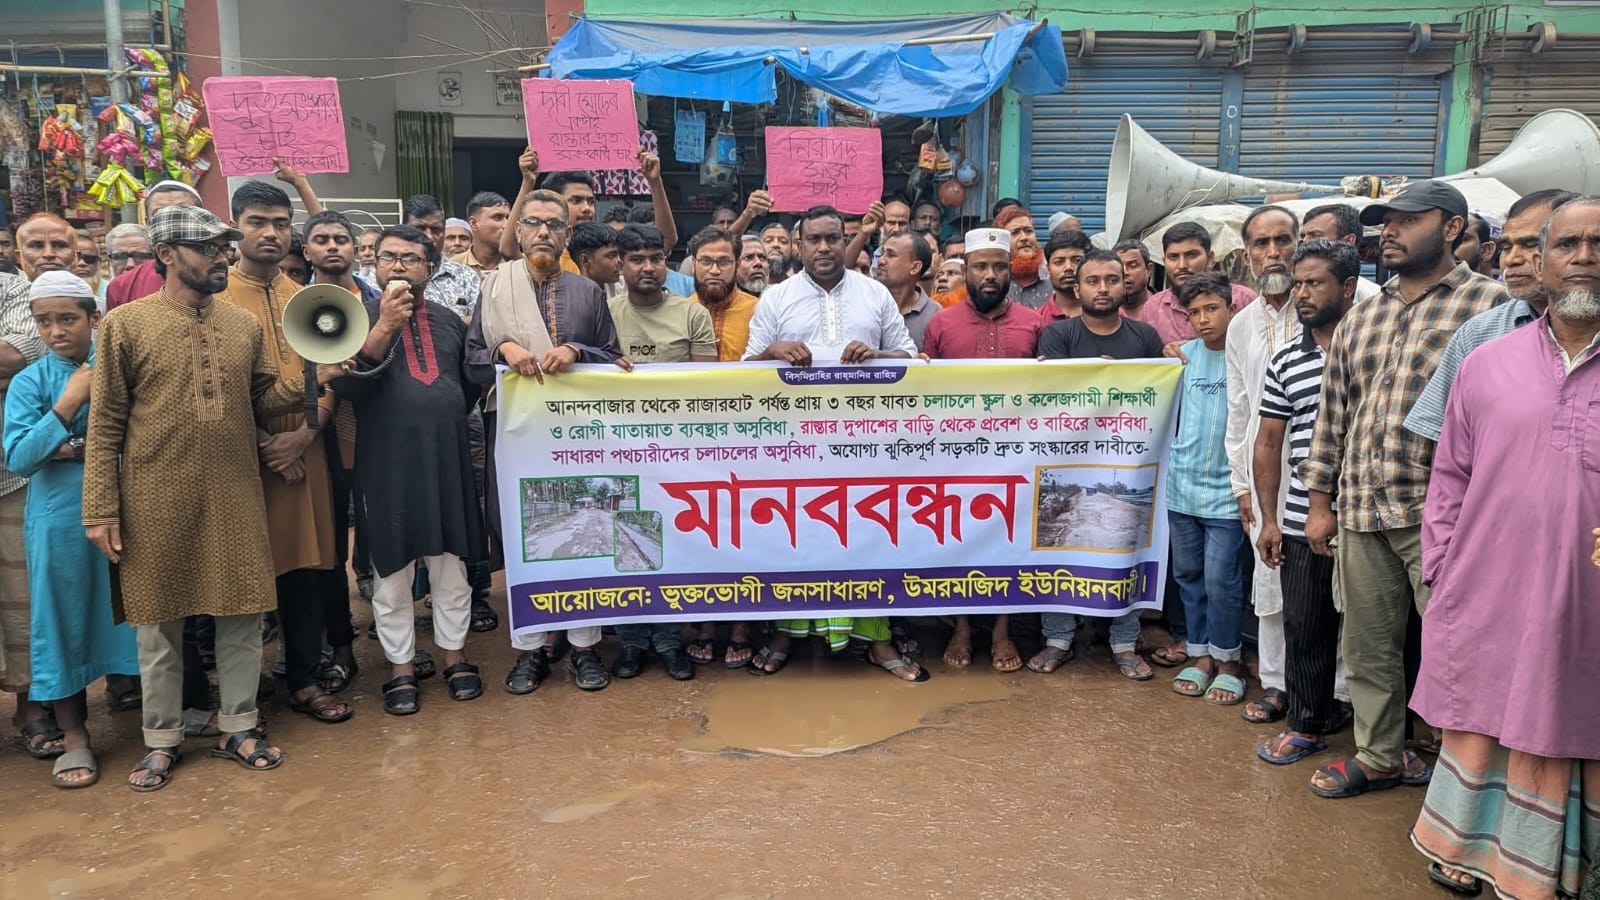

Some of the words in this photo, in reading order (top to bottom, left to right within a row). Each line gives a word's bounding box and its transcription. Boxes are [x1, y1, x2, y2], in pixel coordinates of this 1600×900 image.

[873, 369, 898, 381] রাহিম
[545, 398, 635, 416] আনন্দবাজার
[640, 398, 681, 413] থেকে
[684, 393, 754, 413] রাজারহাট
[759, 392, 790, 411] পর্যন্ত
[795, 395, 822, 411] প্রায়
[827, 398, 839, 409] ৩
[845, 396, 876, 411] বছর
[880, 394, 918, 410] যাবত
[922, 394, 976, 408] চলাচলে
[980, 394, 1005, 412] স্কুল
[1011, 395, 1022, 406] ও
[1027, 387, 1102, 406] কলেজগামী
[1107, 387, 1157, 407] শিক্ষার্থী
[550, 427, 562, 439] ও
[569, 420, 606, 440] রোগী
[610, 423, 673, 439] যাতায়াত
[678, 422, 729, 439] ব্যবস্থার
[800, 420, 838, 434] রাস্তার
[843, 419, 898, 437] দুপাশের
[903, 414, 935, 435] বাড়ি
[940, 418, 976, 432] থেকে
[981, 416, 1021, 432] প্রবেশ
[1027, 418, 1038, 430] ও
[1043, 412, 1090, 432] বাহিরে
[552, 449, 605, 464] সাধারণ
[611, 443, 690, 464] পথচারীদের
[695, 446, 758, 461] চলাচলের
[828, 443, 879, 458] অযোগ্য
[884, 437, 936, 461] ঝুকিপূর্ণ
[939, 437, 990, 459] সড়কটি
[994, 442, 1024, 458] দ্রুত
[1029, 441, 1089, 456] সংস্কারের
[659, 471, 1030, 549] মানববন্ধন
[659, 575, 765, 611] ভুক্তভোগী
[903, 569, 1012, 598] উমরমজিদ
